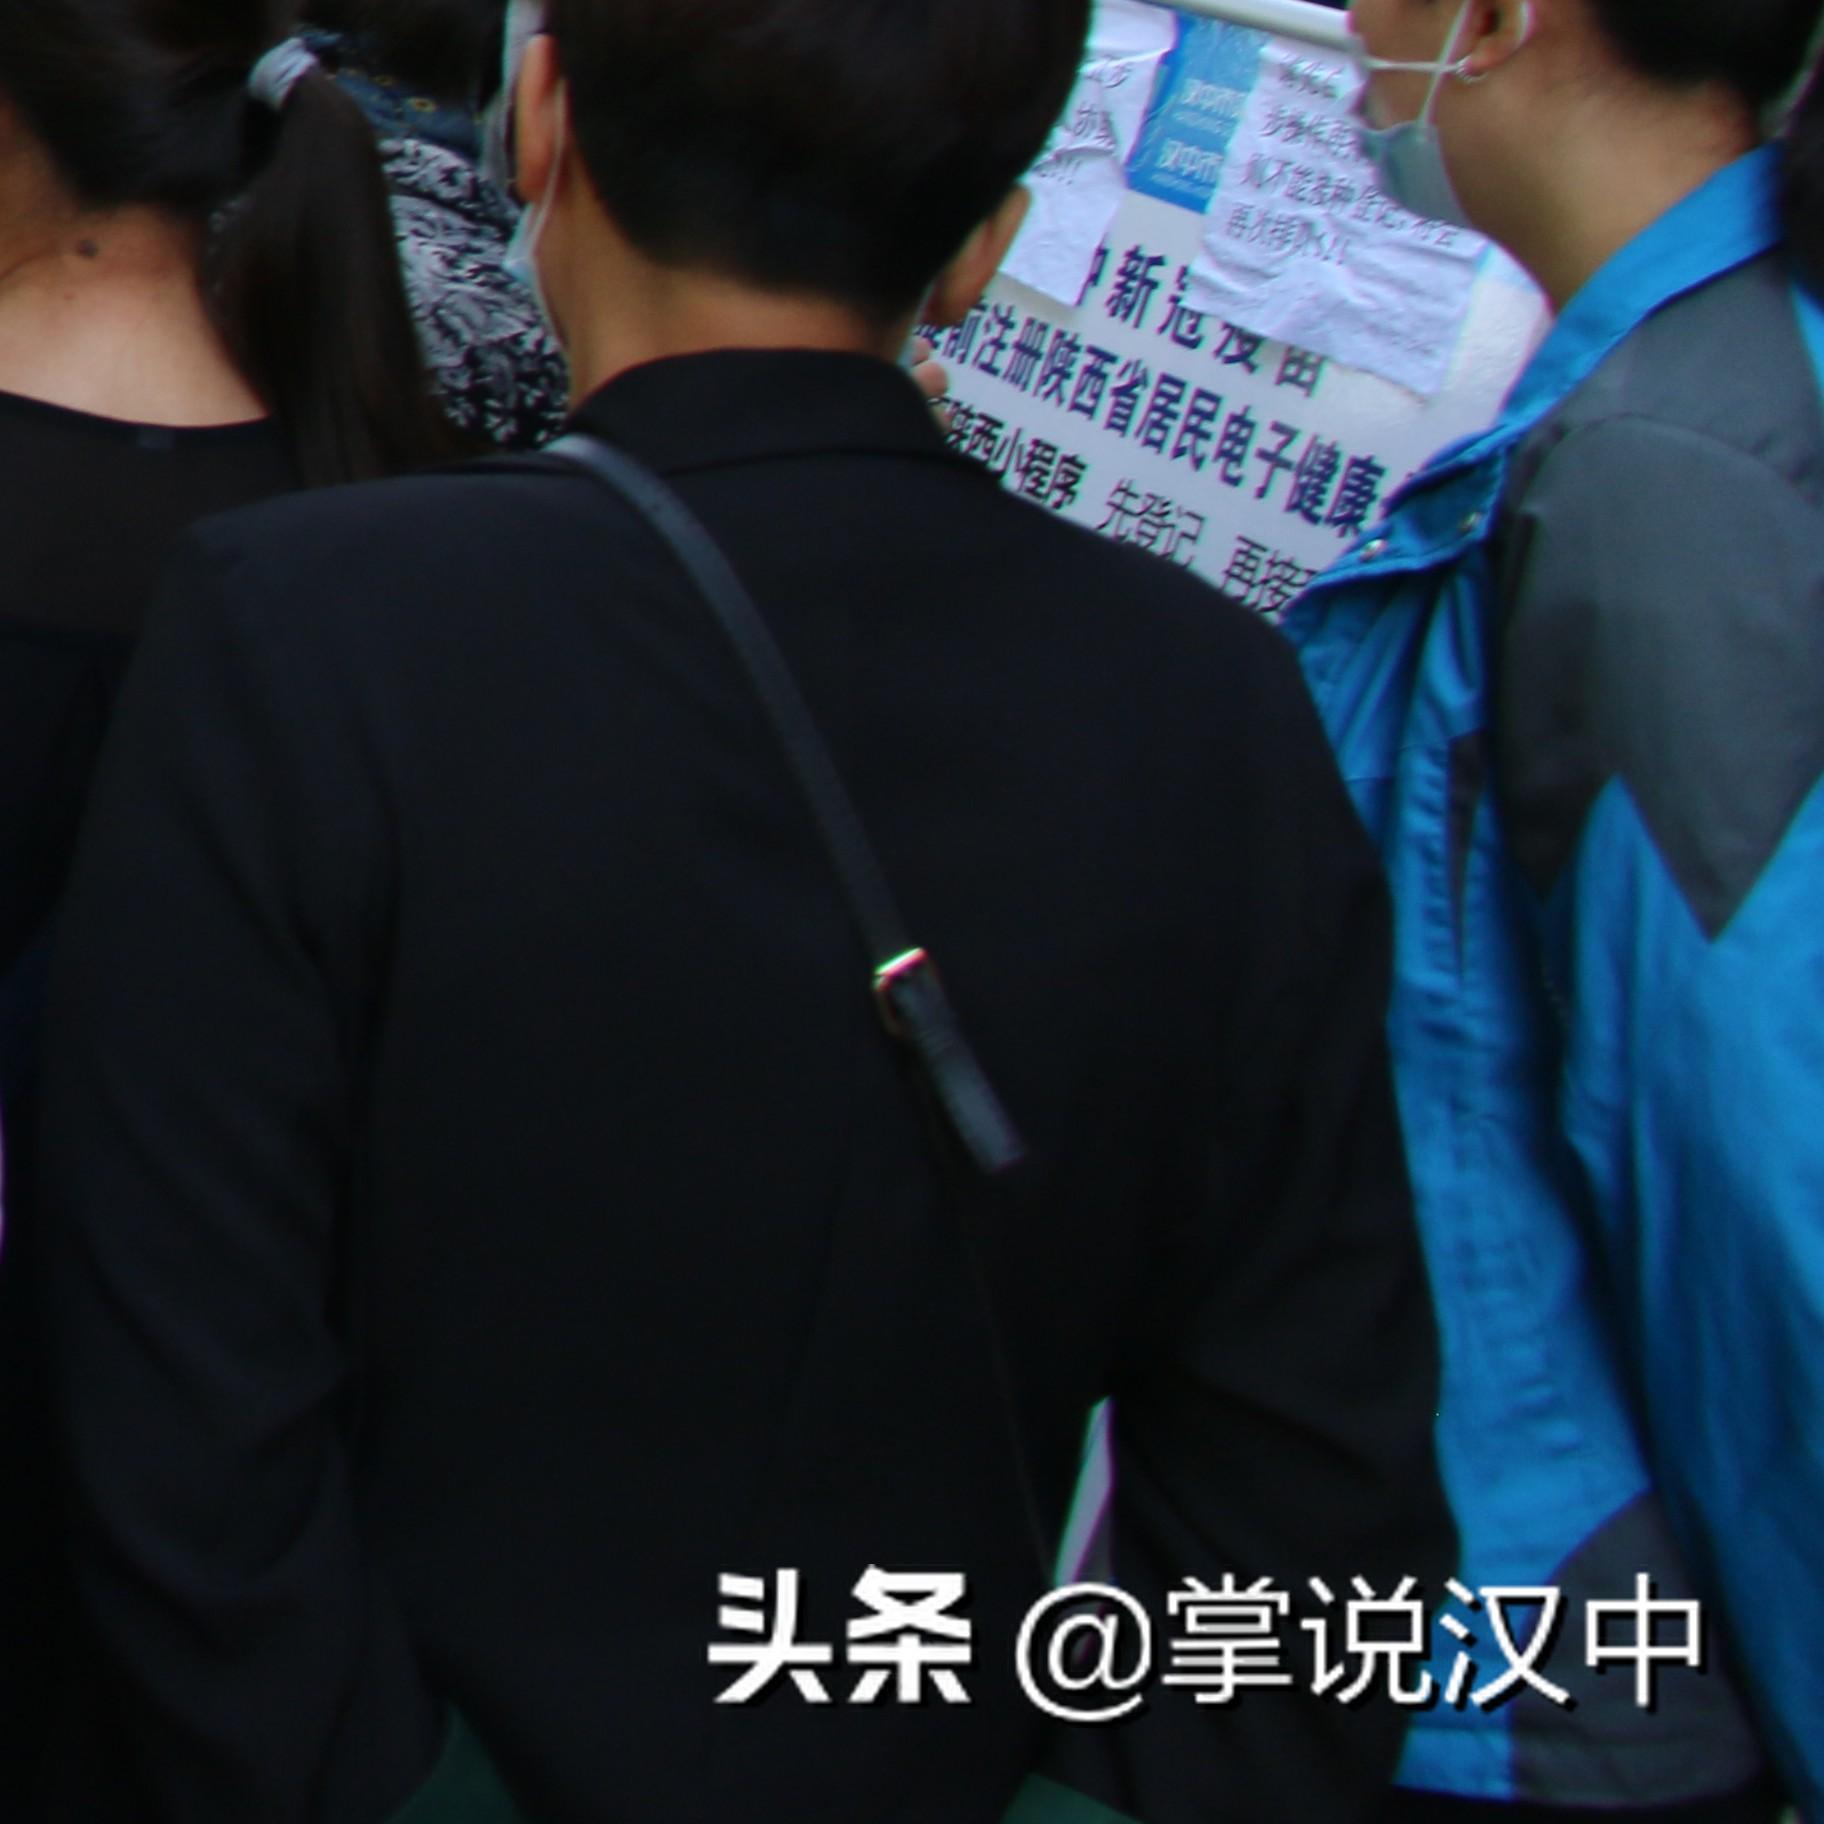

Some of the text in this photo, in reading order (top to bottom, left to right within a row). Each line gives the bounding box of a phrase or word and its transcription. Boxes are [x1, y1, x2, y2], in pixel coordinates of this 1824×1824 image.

[928, 395, 1320, 614] 陕西小程序 先登记 再接
